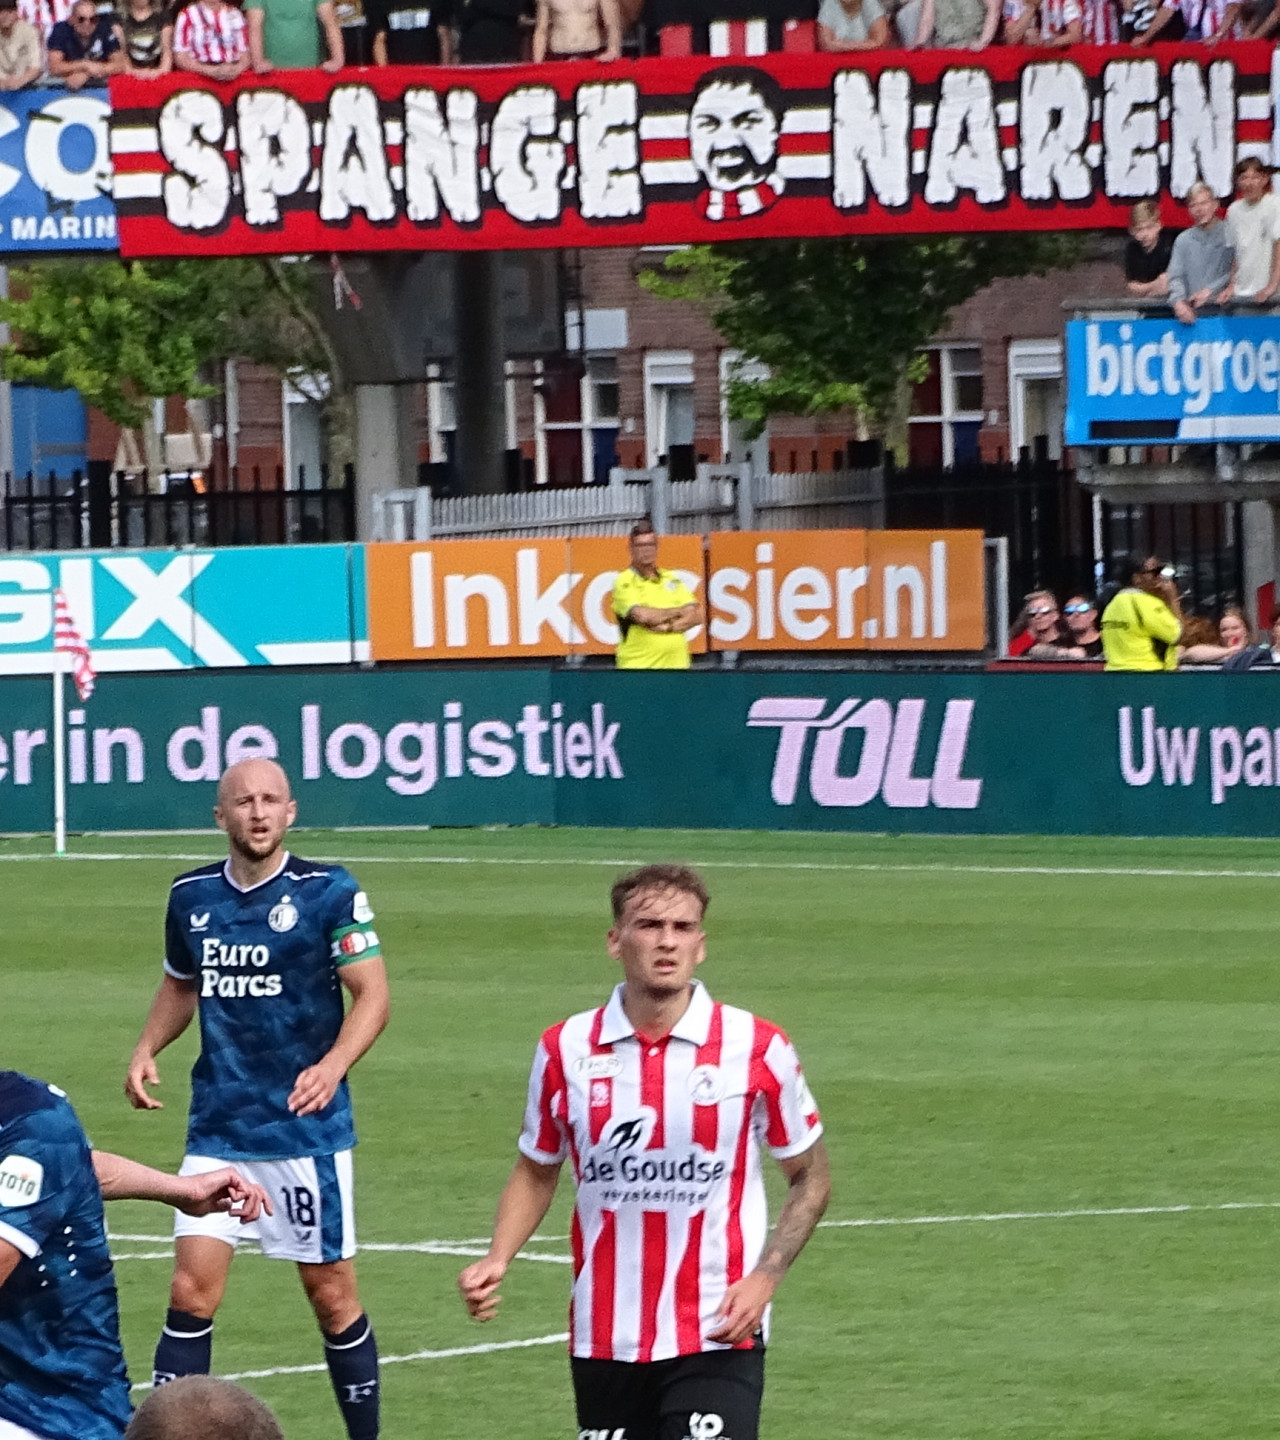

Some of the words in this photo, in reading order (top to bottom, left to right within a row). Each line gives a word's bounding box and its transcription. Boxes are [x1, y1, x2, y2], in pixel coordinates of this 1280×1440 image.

[159, 81, 642, 230] SPANGE
[832, 59, 1235, 209] NAREN
[410, 540, 947, 648] Inksier.nl
[68, 708, 144, 784] in
[167, 705, 279, 783] de
[301, 699, 624, 797] logistiek
[746, 697, 982, 808] TOLL
[1118, 706, 1201, 788] Uw
[201, 938, 270, 967] Euro
[201, 968, 283, 998] Parcs
[0, 1171, 36, 1197] TOTO
[583, 1156, 615, 1184] de
[621, 1152, 725, 1184] Goudse
[281, 1186, 317, 1227] 18
